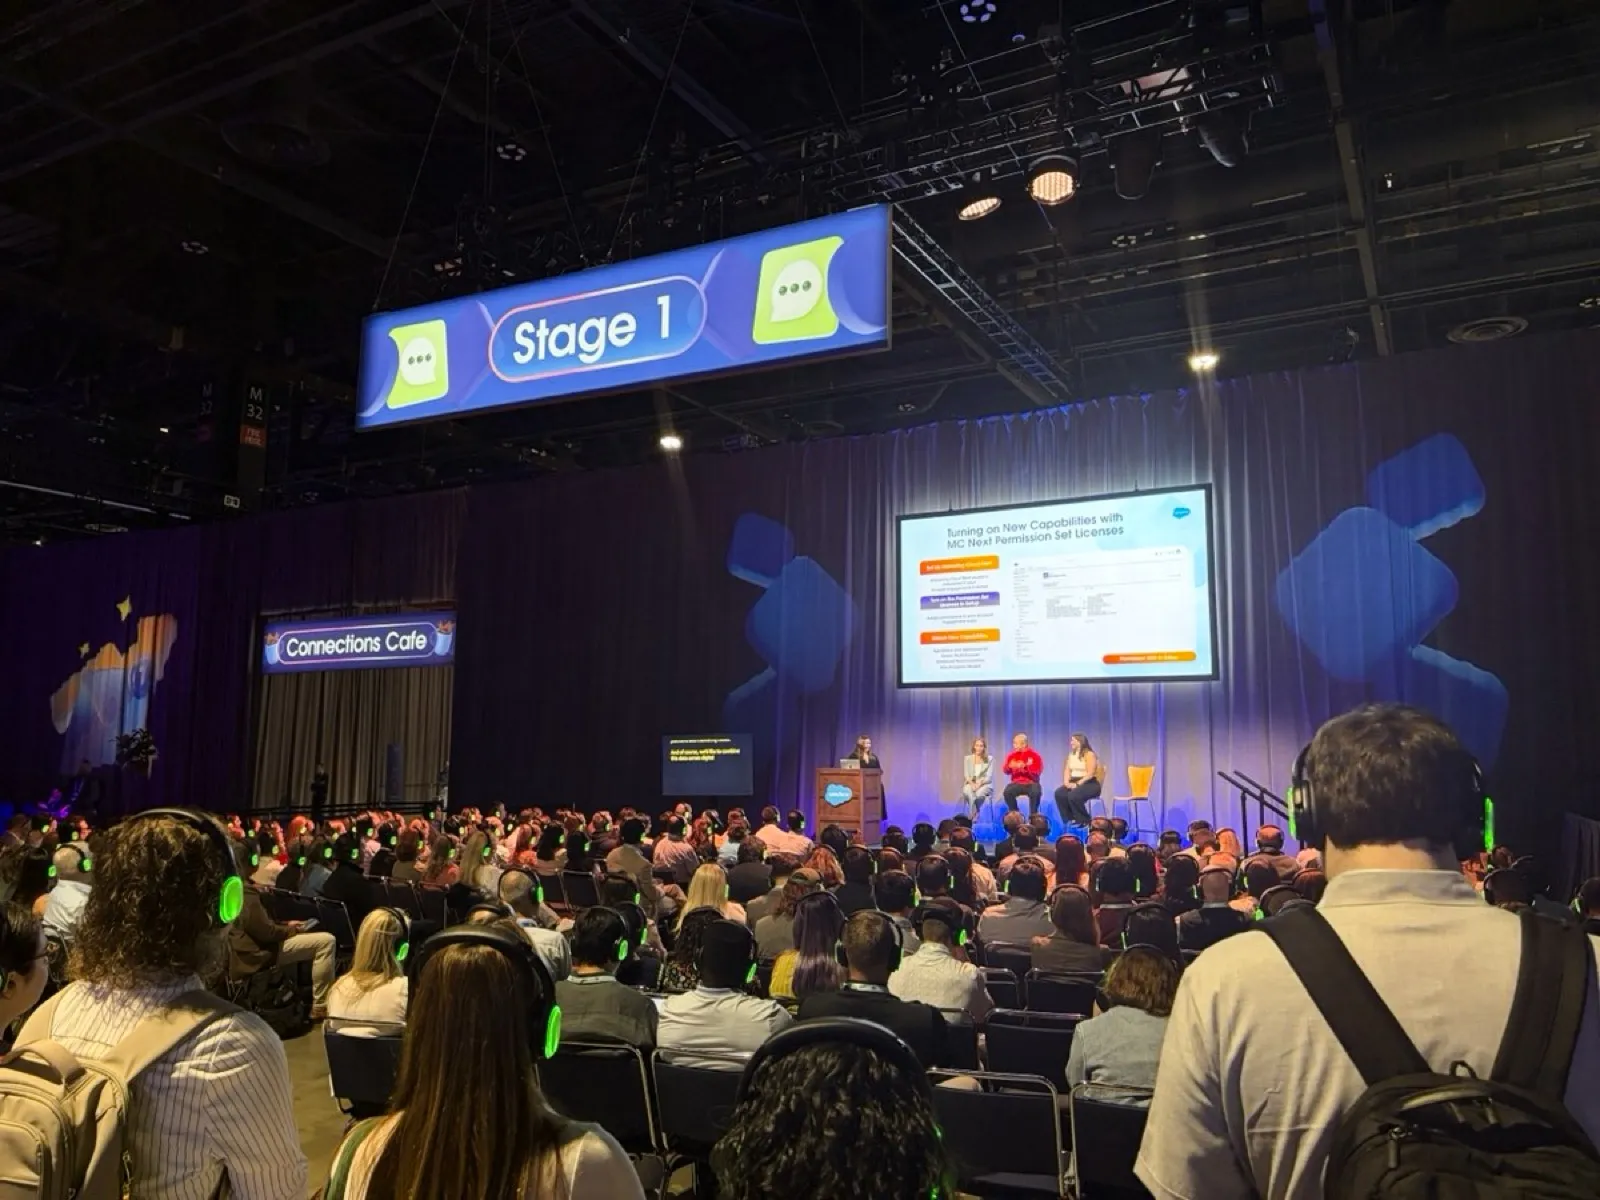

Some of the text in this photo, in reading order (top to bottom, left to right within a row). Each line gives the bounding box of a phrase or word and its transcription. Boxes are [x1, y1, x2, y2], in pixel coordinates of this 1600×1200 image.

[513, 295, 670, 364] Stage 1
[250, 386, 262, 401] M
[247, 403, 263, 420] 32
[947, 513, 1124, 539] Turning on New Capabilities with
[947, 525, 1125, 549] MC Next Permission Set Licenses
[286, 630, 428, 657] Connections Cafe
